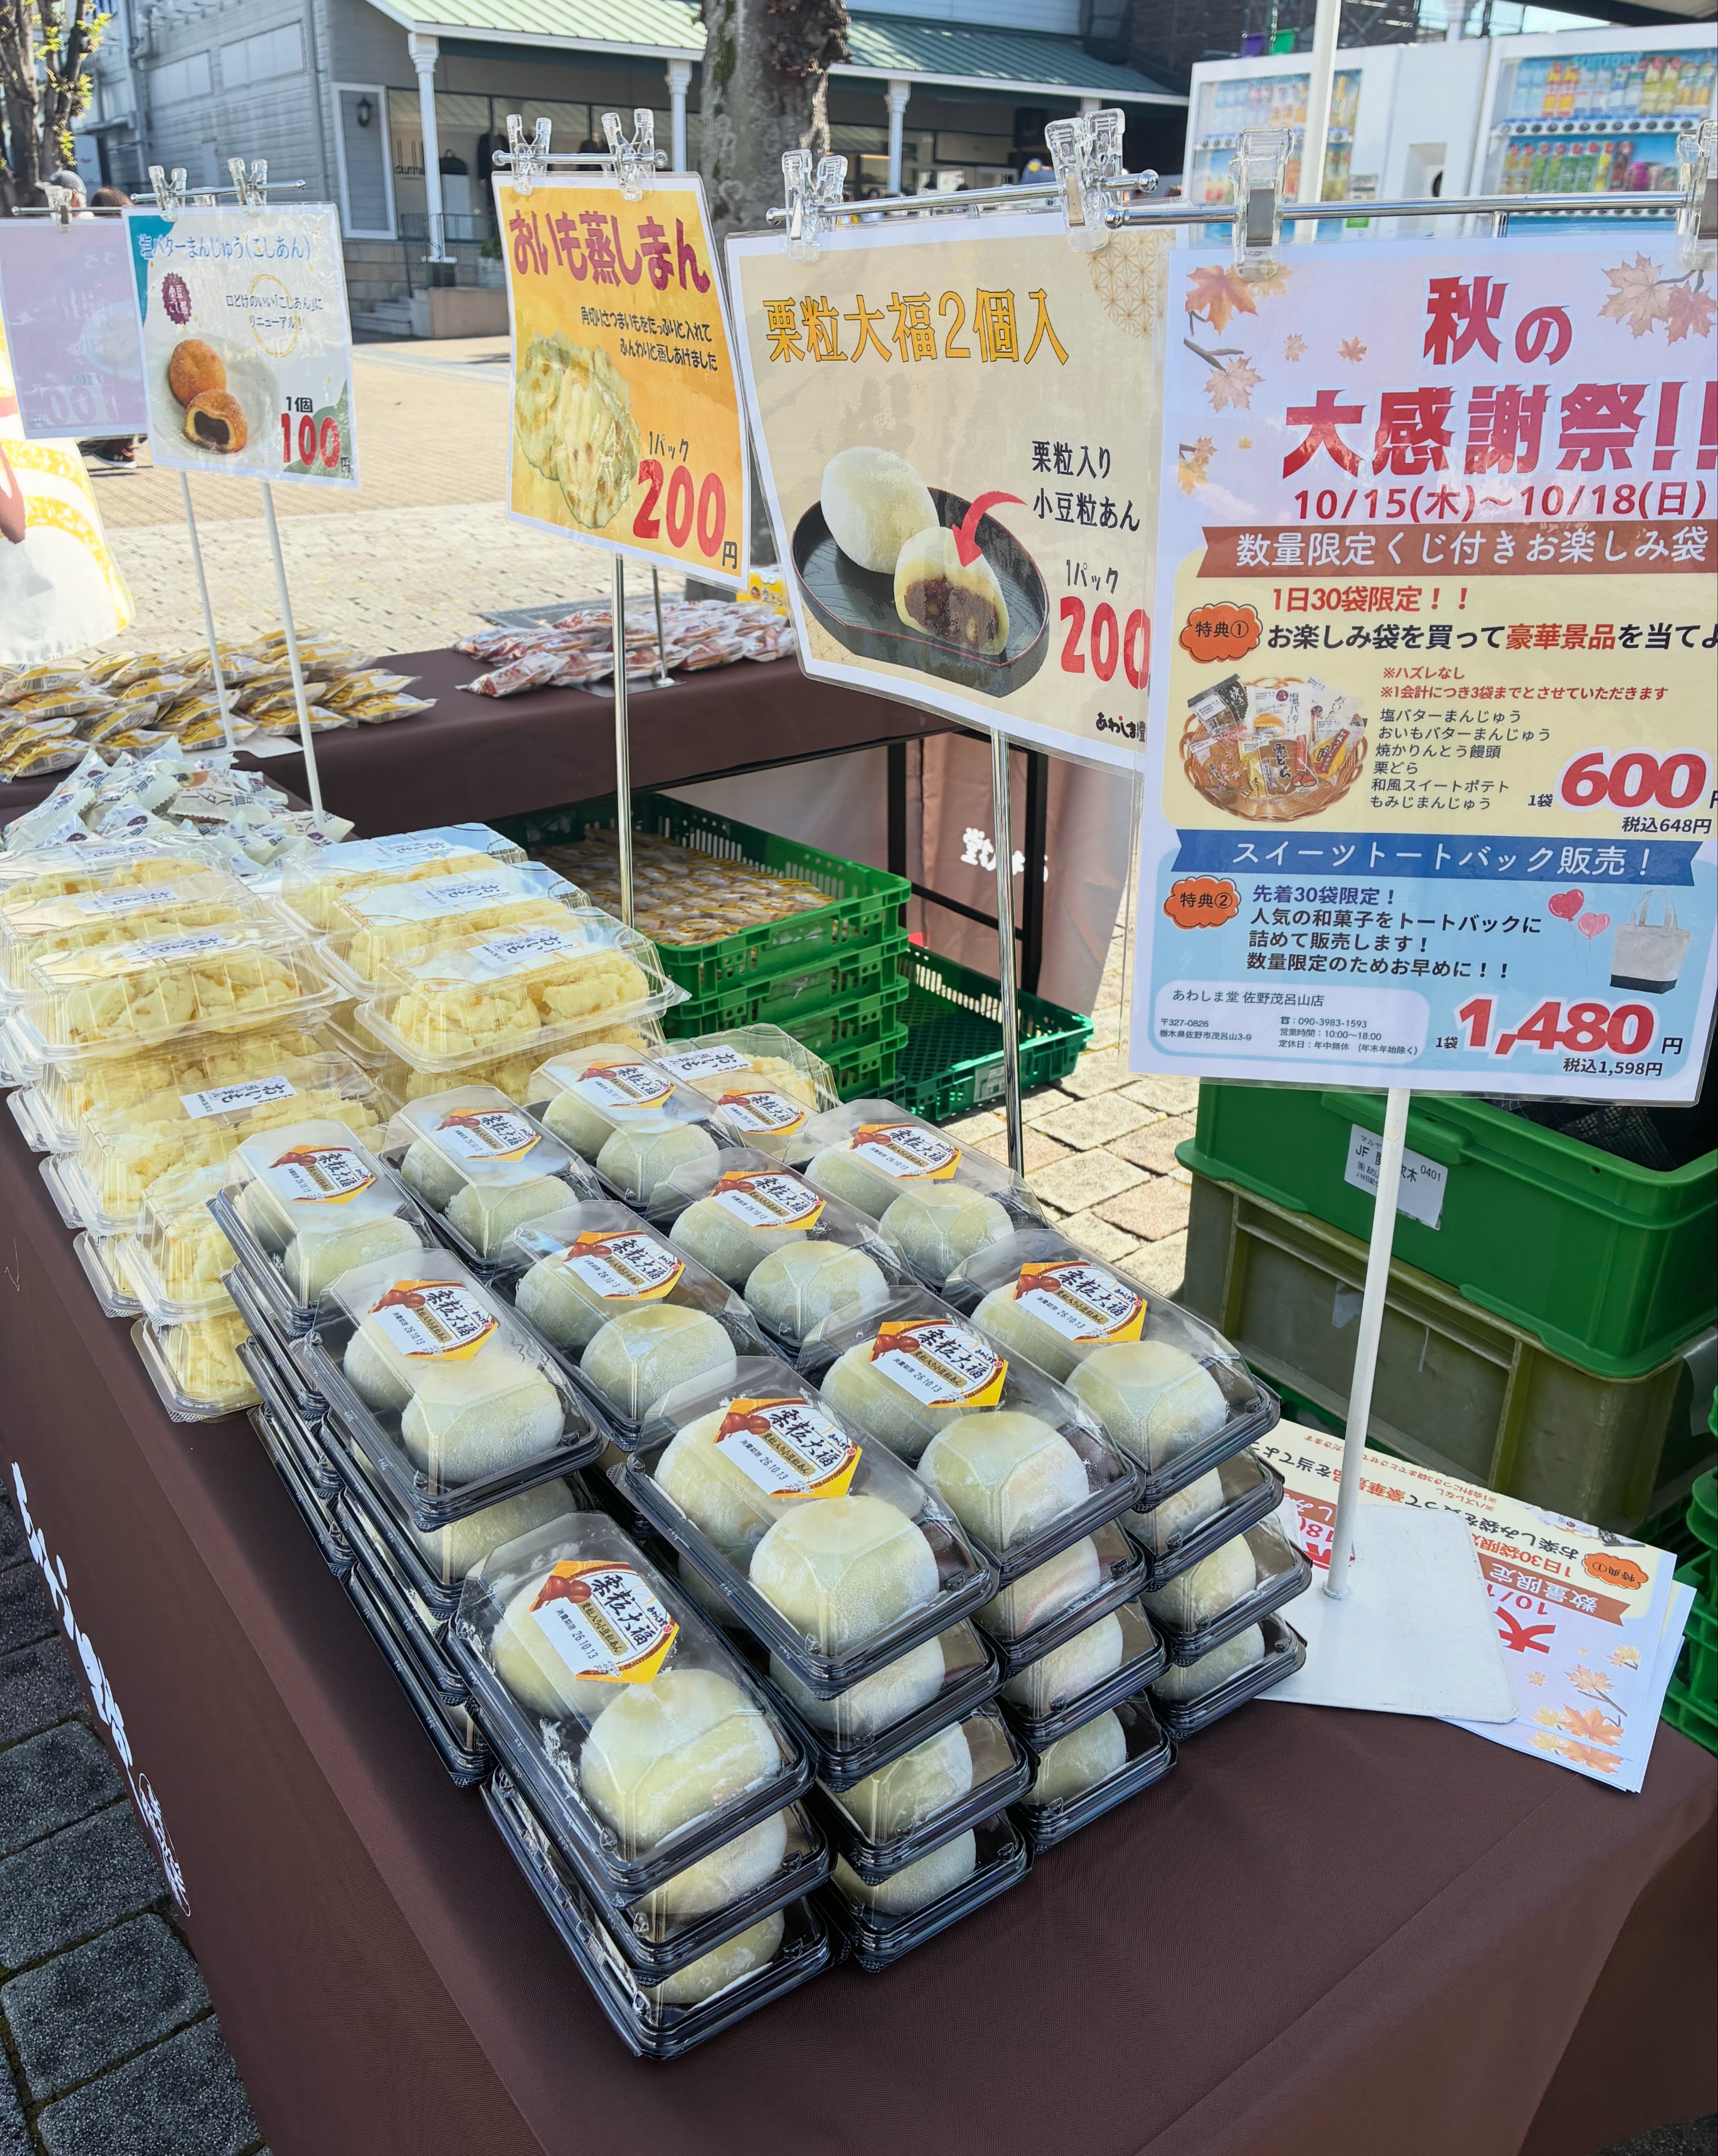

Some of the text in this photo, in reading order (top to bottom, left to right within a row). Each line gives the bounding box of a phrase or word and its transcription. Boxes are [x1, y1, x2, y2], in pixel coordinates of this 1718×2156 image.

[510, 209, 710, 294] おいも蒸しまん
[581, 305, 712, 343] 角切りさつまいもをたっぷりと入れて
[762, 288, 1069, 365] 栗粒大福2個入
[1423, 275, 1573, 366] 秋の
[620, 337, 718, 372] ふんわりと蒸しあげました
[286, 396, 313, 413] 1個
[281, 413, 341, 468] 100
[649, 431, 689, 462] 1パック
[1031, 440, 1111, 479] 栗粒入り
[633, 458, 738, 570] 200 円
[1032, 488, 1140, 532] 小豆粒あん
[1236, 526, 1709, 567] 数量限定くじ付きお楽しみ袋
[1066, 559, 1118, 594] 1パック
[1060, 596, 1151, 690] 200
[1380, 708, 1522, 724] 塩バターまんじゅう
[1375, 744, 1502, 760] 焼かりんとう饅頭
[1378, 726, 1551, 743] おいもバターまんじゅう
[1371, 778, 1510, 794] 和風スイートポテト
[1373, 761, 1418, 776] 栗どら
[1528, 794, 1553, 808] 1袋
[1560, 753, 1707, 810] 600
[1370, 795, 1492, 811] もみじまんじゅう
[1622, 816, 1712, 835] 税込648円
[1250, 909, 1541, 935] 人気の和菓子をトートバックに
[1173, 990, 1325, 1007] あわしま堂 佐野茂呂山店
[1159, 1030, 1252, 1041] 栃木県佐野市茂呂山3-9
[1436, 999, 1682, 1056] 1袋 1,480 円
[1563, 1058, 1663, 1077] 税込1,598円
[222, 1084, 285, 1103] おいも
[1356, 1145, 1370, 1157] JF
[1421, 1165, 1441, 1182] 0401
[1058, 1270, 1127, 1317] 栗粒大福
[1057, 1310, 1086, 1329] 26.10.13
[918, 1329, 985, 1380] 栗粒大福
[913, 1372, 942, 1393] 26.10.13
[769, 1409, 841, 1468] 栗粒大福
[760, 1456, 788, 1480] 26.10.13
[592, 1574, 656, 1645] 栗粒大福
[572, 1631, 598, 1659] 26.10.13
